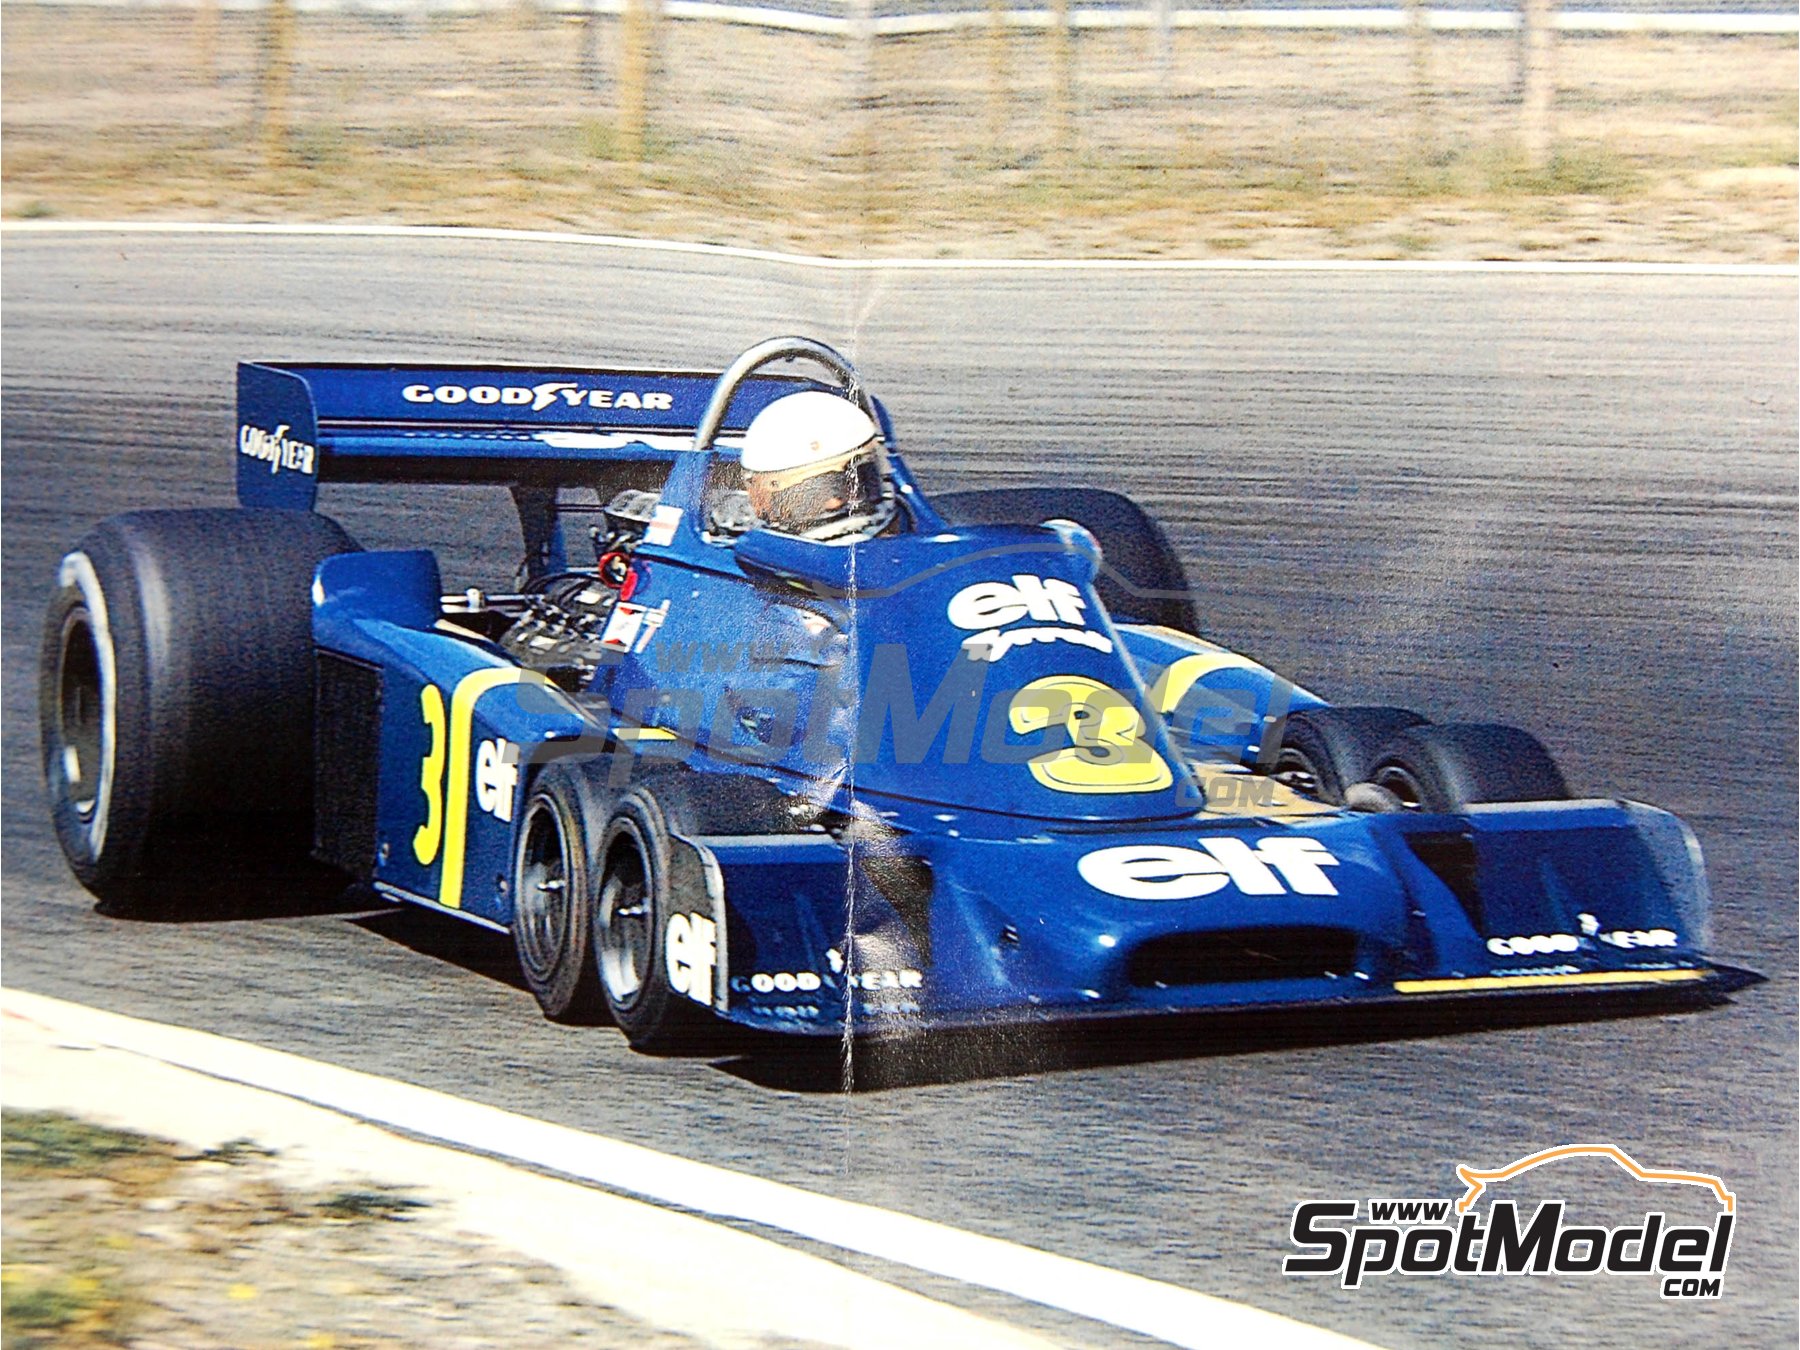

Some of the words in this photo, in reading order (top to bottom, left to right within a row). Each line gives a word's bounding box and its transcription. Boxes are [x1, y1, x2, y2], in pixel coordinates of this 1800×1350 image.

[402, 382, 674, 411] GOODYEAR
[947, 574, 1086, 630] elf
[1009, 675, 1174, 793] 3
[413, 684, 446, 865] 3
[475, 737, 520, 822] elf
[1077, 837, 1340, 900] elf
[665, 911, 717, 1006] elf
[1486, 913, 1678, 955] GOODEAR
[730, 954, 922, 993] GOODEAR
